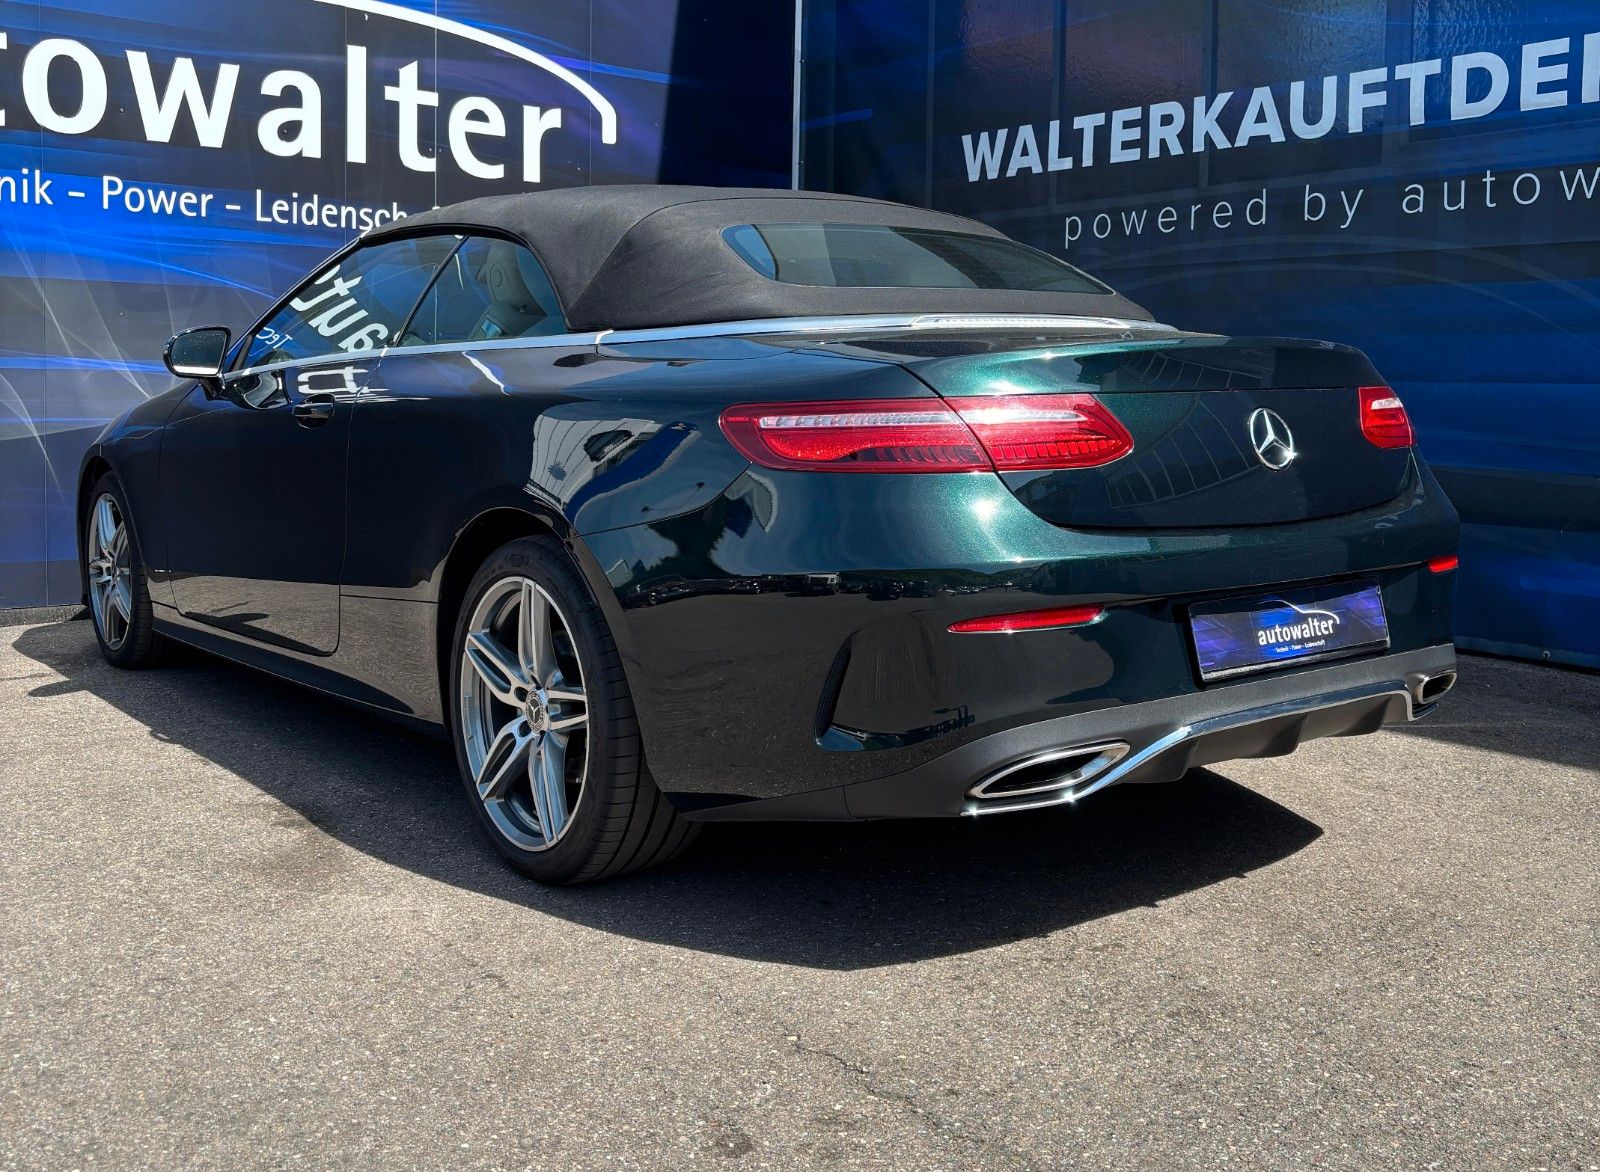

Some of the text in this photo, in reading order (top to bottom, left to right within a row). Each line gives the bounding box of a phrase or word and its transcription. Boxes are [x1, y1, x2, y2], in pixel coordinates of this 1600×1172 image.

[0, 31, 562, 183] owalter
[103, 175, 214, 217] Power
[256, 189, 408, 231] Leidensch
[1064, 166, 1600, 249] powered by autow
[1257, 617, 1334, 646] autowalter
